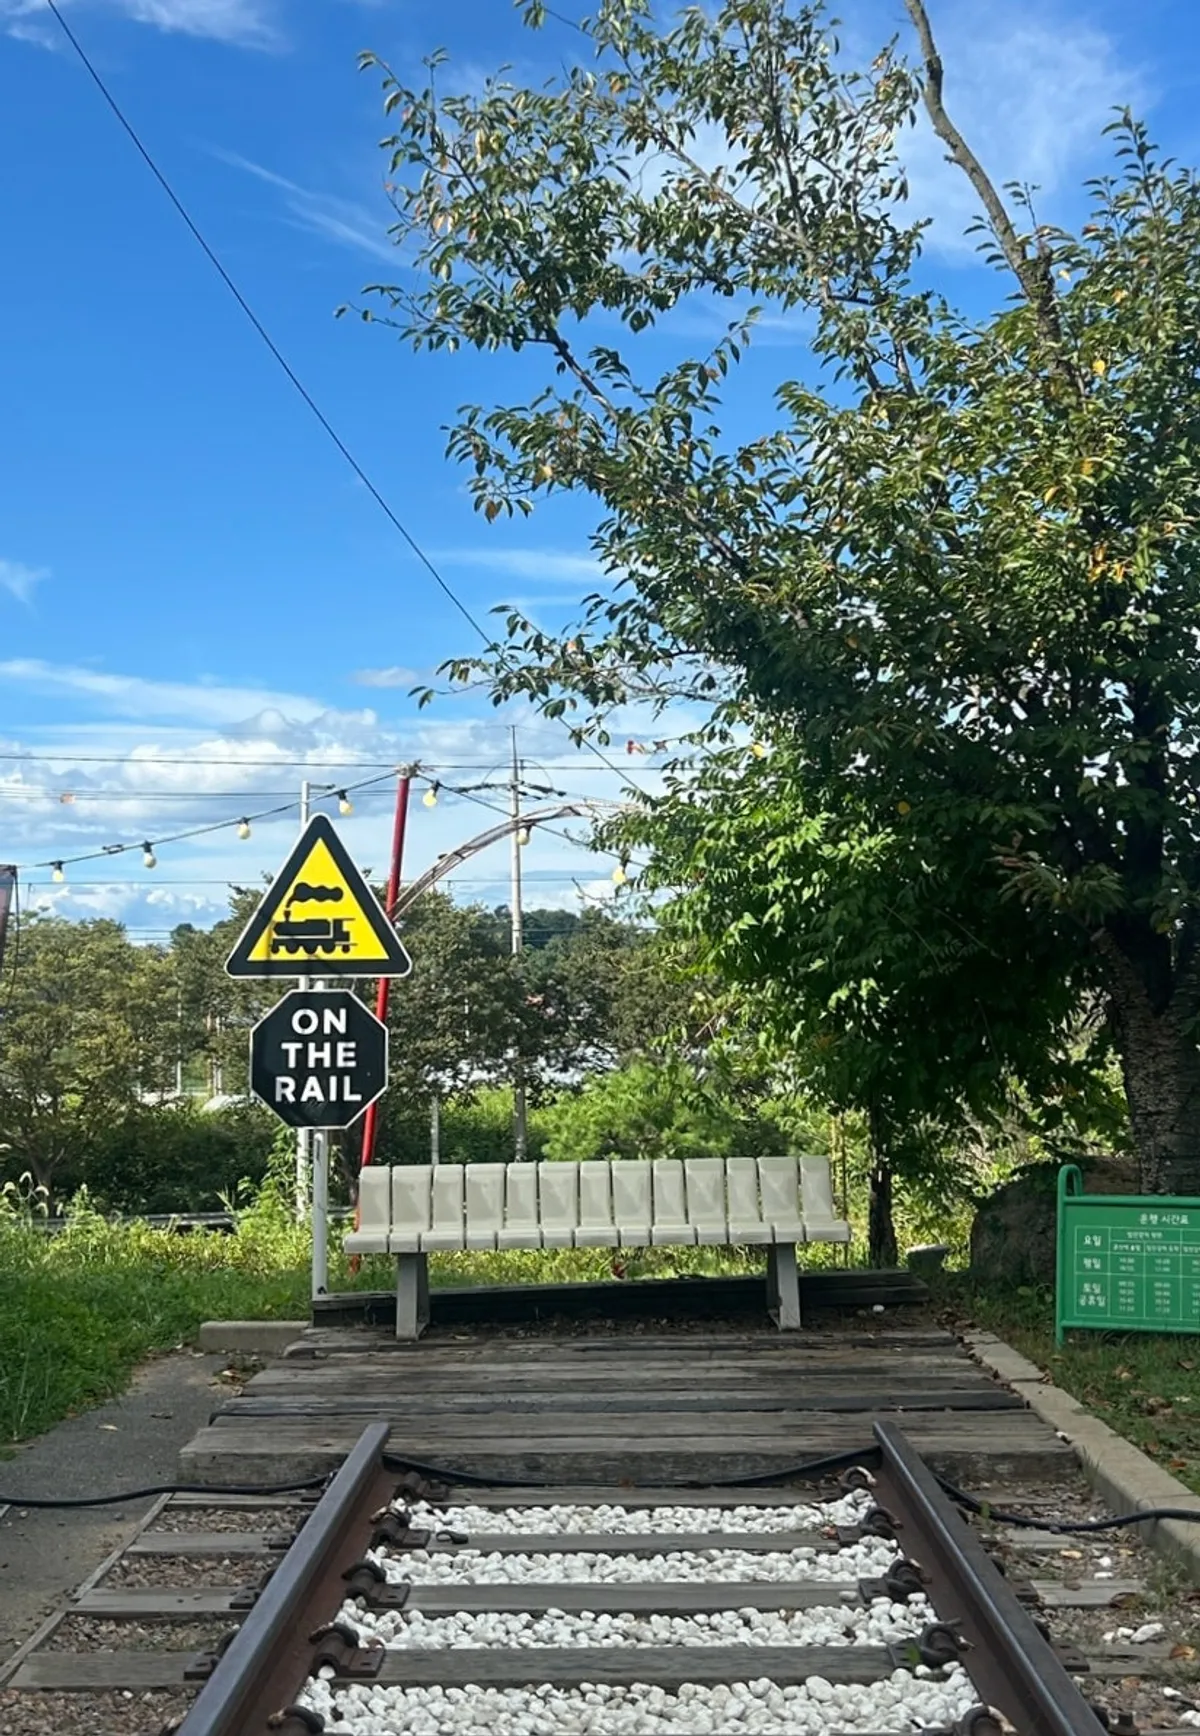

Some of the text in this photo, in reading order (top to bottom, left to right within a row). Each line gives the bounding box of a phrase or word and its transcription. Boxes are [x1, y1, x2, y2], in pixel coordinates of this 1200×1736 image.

[291, 1008, 346, 1035] ON
[281, 1042, 357, 1068] THE
[275, 1075, 362, 1102] RAIL
[1161, 1214, 1189, 1225] 시간표
[1083, 1235, 1102, 1247] 요일
